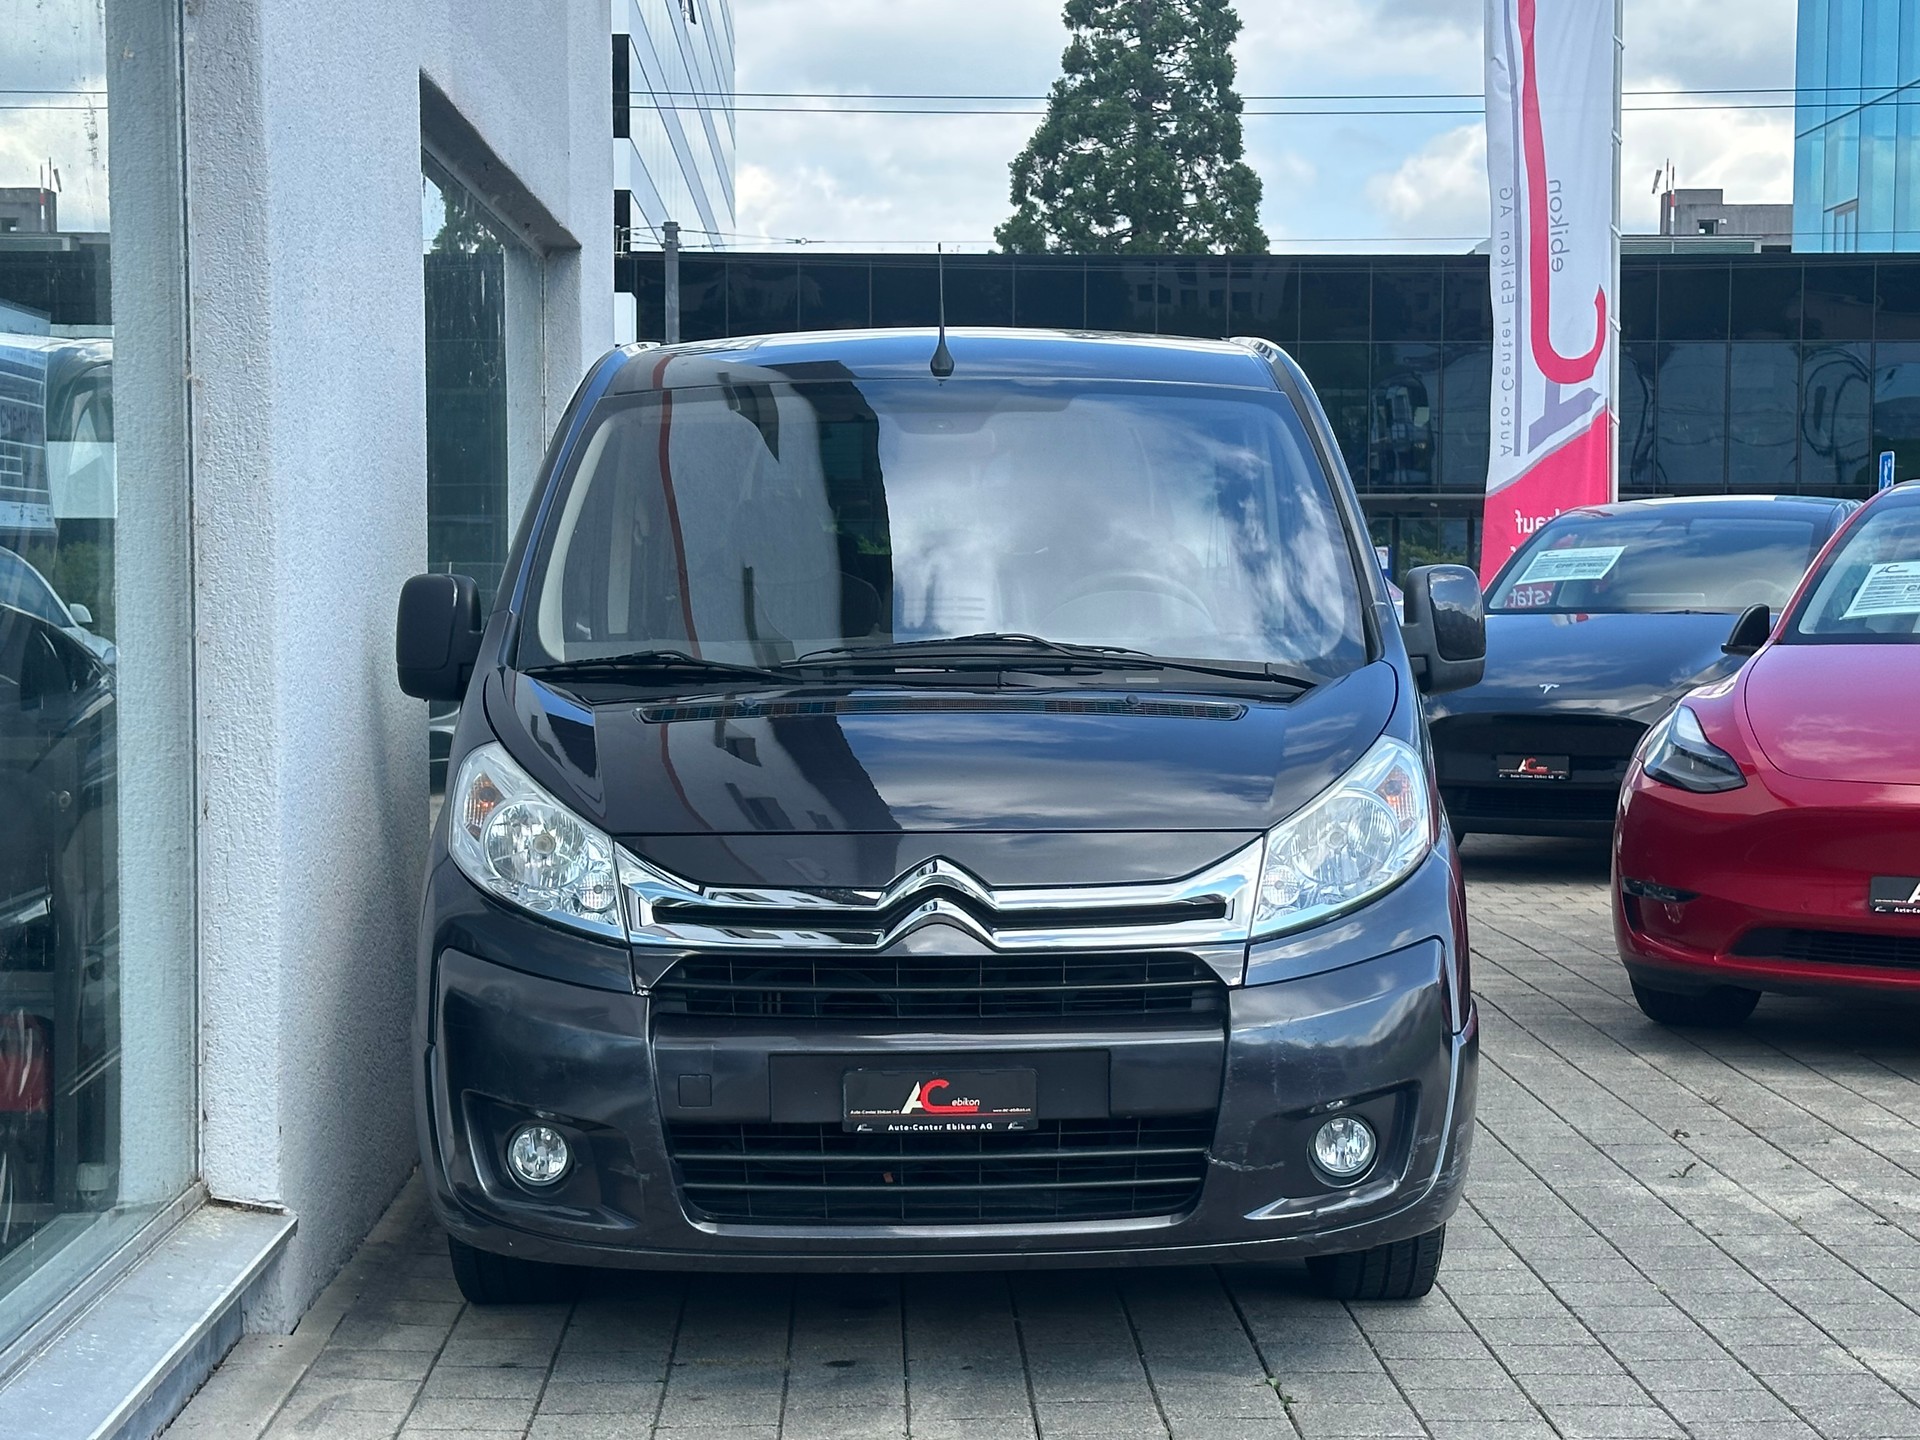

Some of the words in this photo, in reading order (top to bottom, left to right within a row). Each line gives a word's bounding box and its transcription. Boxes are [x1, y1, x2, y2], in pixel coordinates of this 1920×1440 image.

[1907, 882, 1920, 904] A
[1894, 906, 1920, 914] Auto-Ce
[951, 1097, 980, 1107] ebikon
[946, 1122, 977, 1131] Ebikon
[979, 1122, 993, 1130] AG
